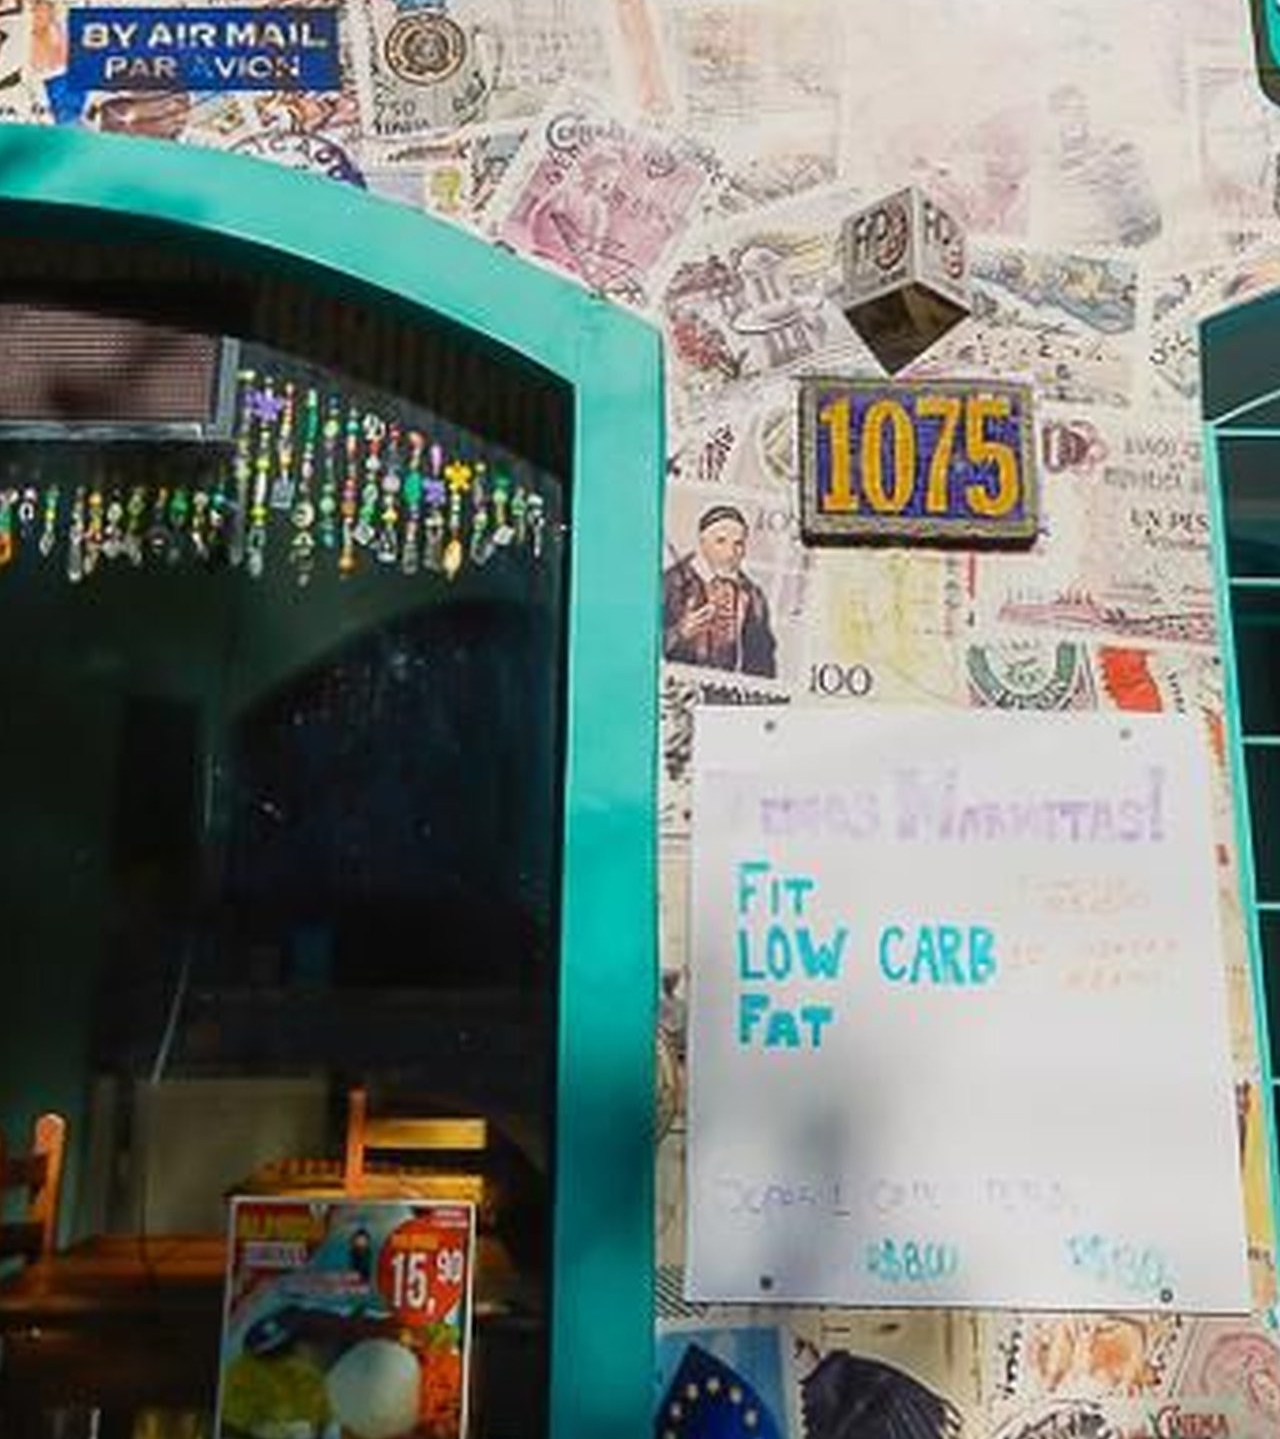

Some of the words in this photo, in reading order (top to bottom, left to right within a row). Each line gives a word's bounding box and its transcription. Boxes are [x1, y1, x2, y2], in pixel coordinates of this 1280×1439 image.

[82, 23, 135, 48] BY
[147, 22, 218, 48] AIR
[227, 22, 325, 47] MAIL
[104, 56, 177, 78] PAR
[821, 394, 1020, 519] 1075
[809, 662, 873, 697] 100
[738, 927, 849, 982] LOW
[878, 924, 999, 987] CARB
